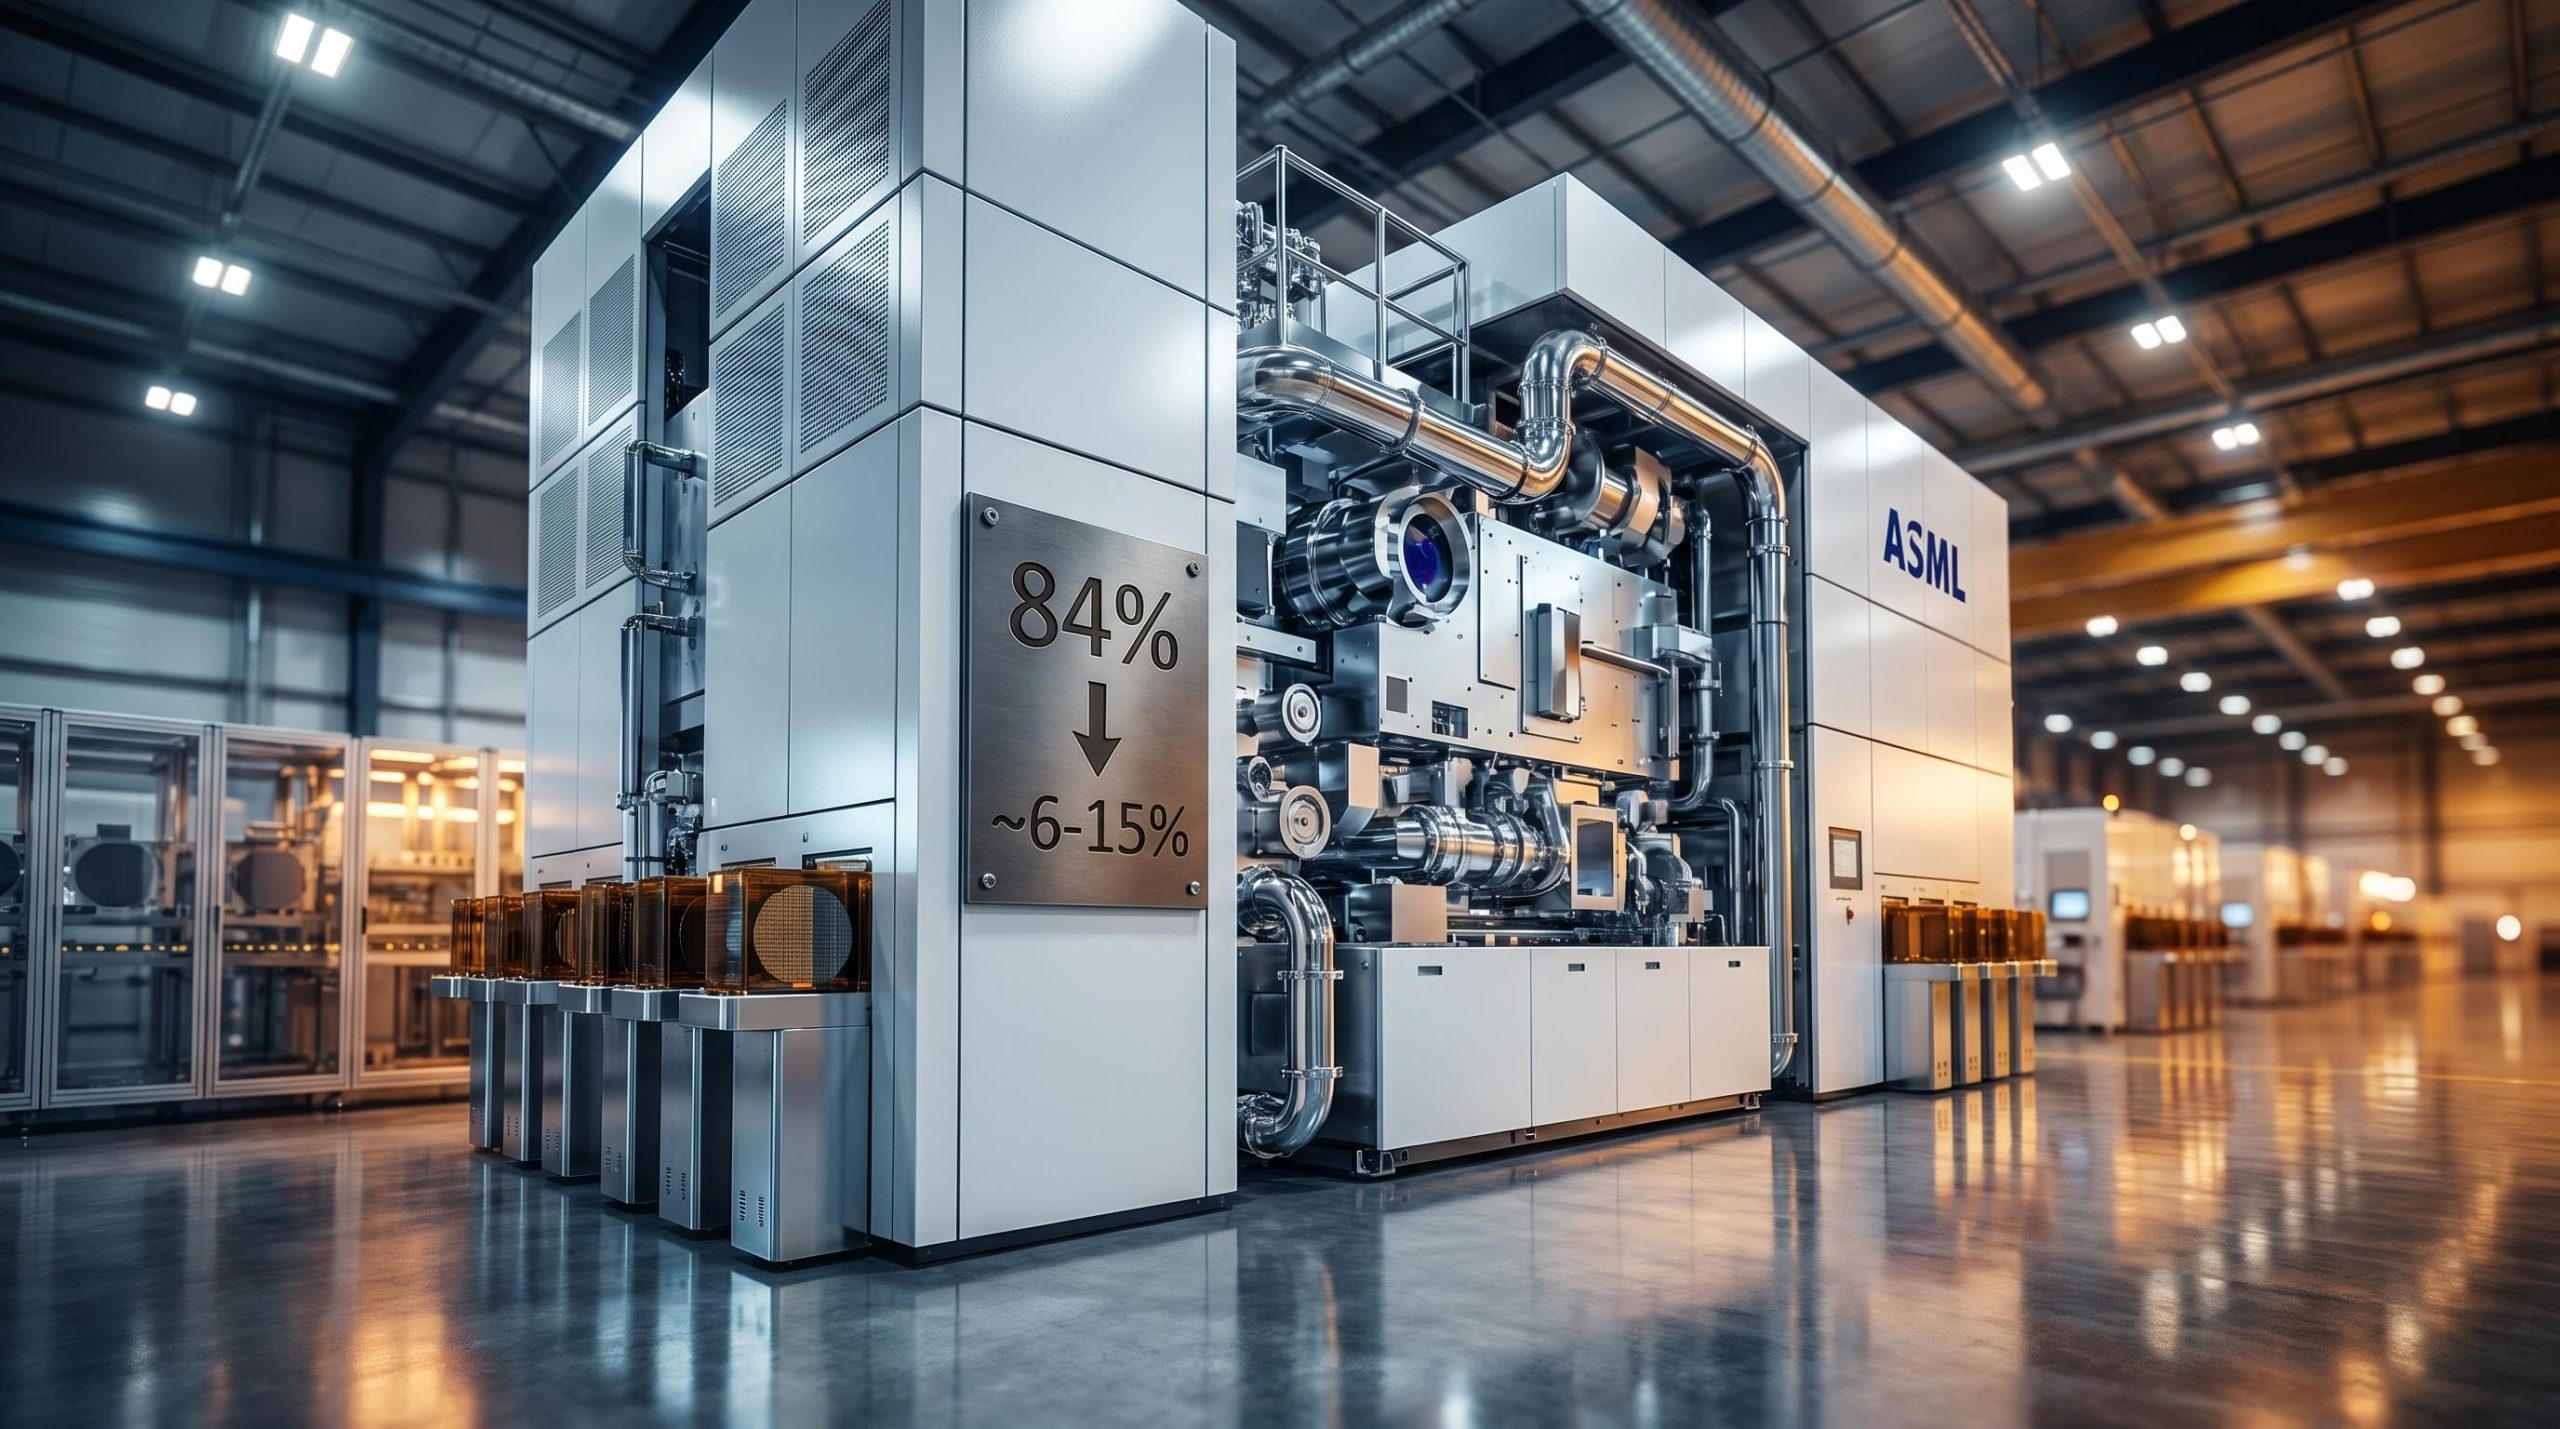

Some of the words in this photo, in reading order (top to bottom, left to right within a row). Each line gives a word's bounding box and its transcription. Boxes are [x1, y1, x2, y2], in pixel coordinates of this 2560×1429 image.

[1883, 507, 1966, 603] ASML
[1009, 561, 1179, 671] 84%
[992, 795, 1189, 858] ~6-15%
